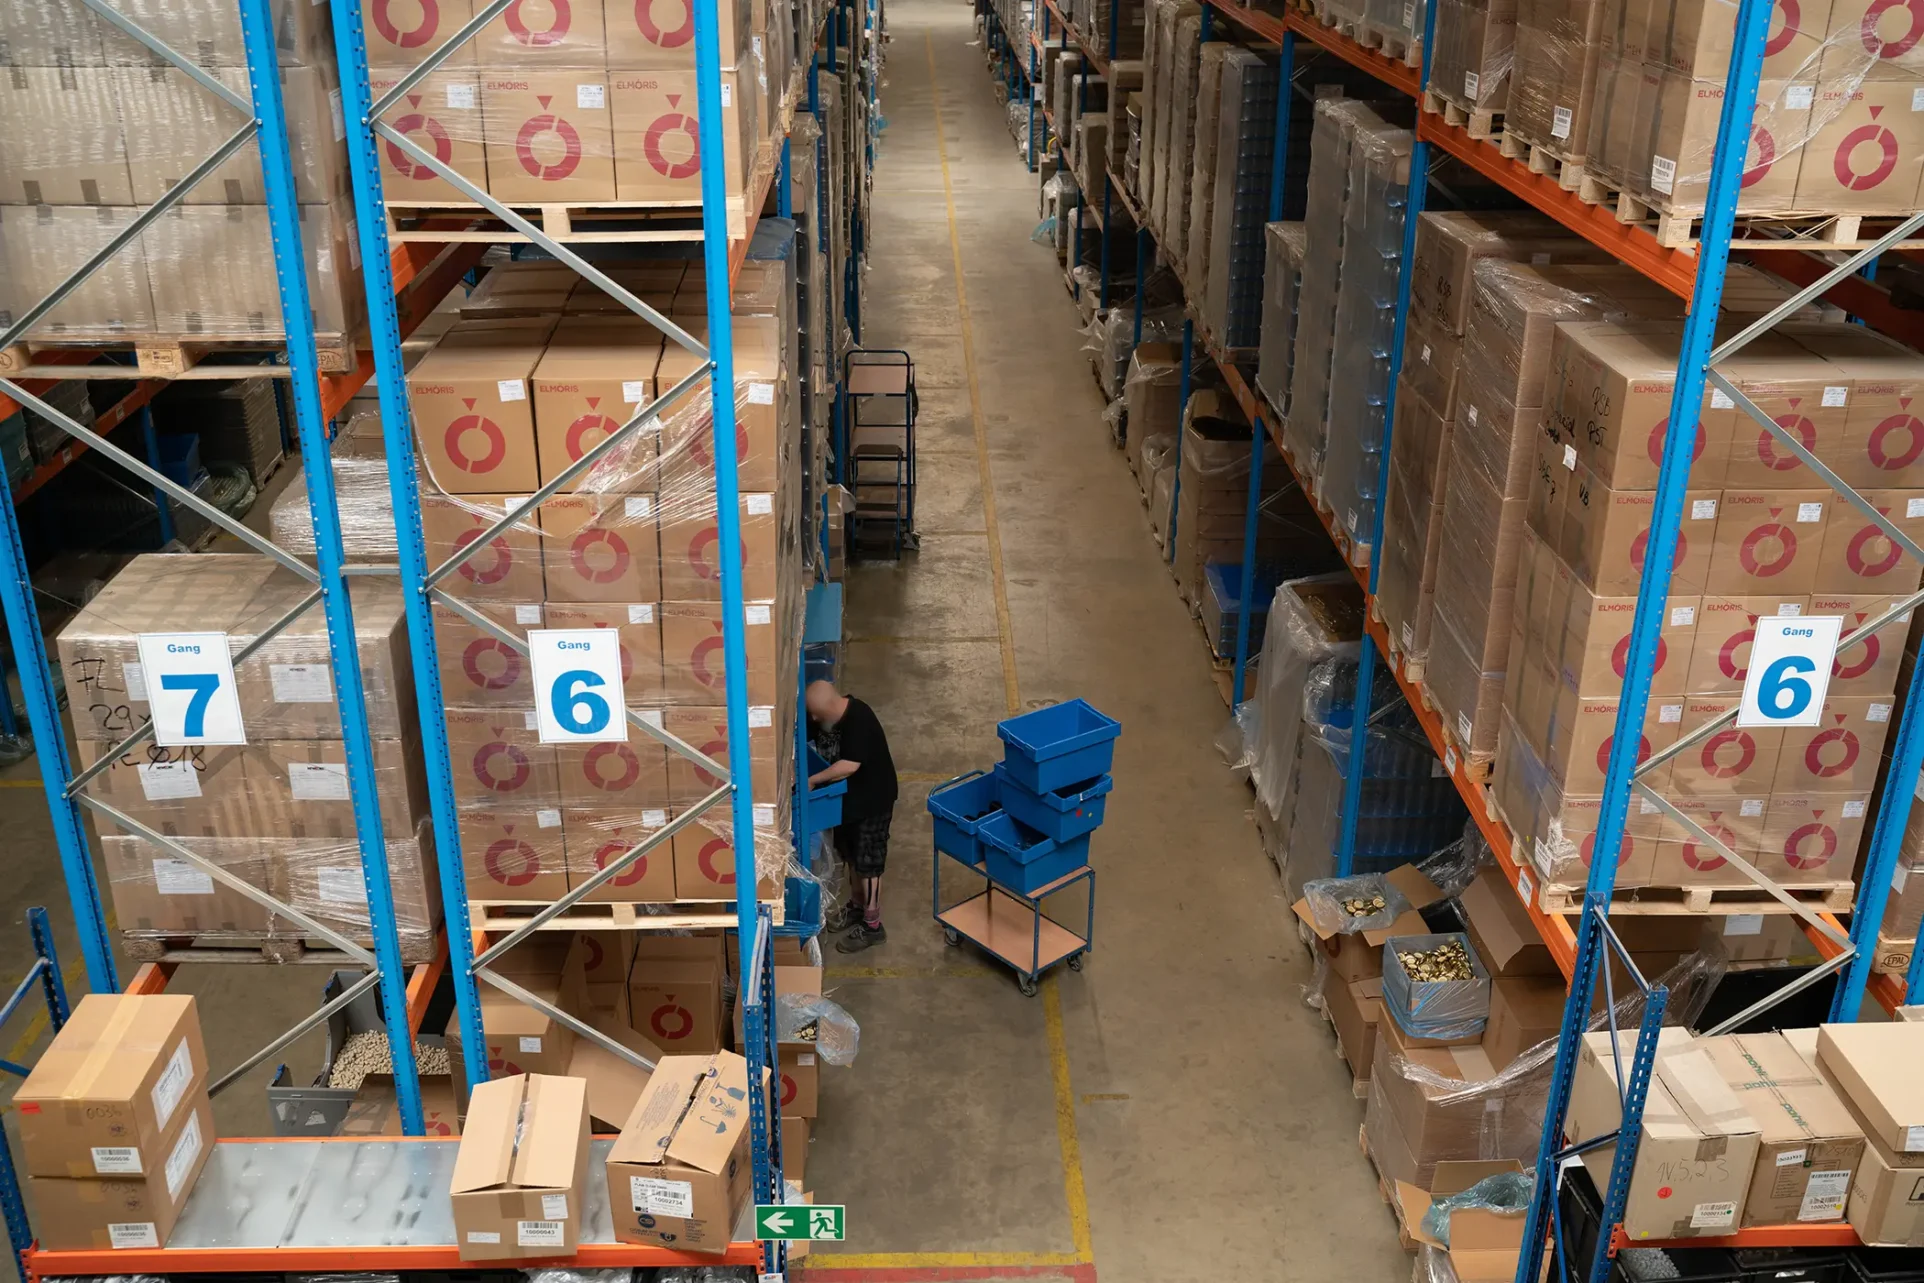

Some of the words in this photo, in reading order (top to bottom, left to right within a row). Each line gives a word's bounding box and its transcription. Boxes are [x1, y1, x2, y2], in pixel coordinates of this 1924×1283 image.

[1782, 627, 1814, 638] Gang
[167, 644, 201, 654] Gang
[557, 641, 591, 651] Gang
[1757, 655, 1816, 719] 6
[160, 674, 220, 737] 7
[551, 669, 611, 734] 6
[1887, 956, 1905, 965] EPAL
